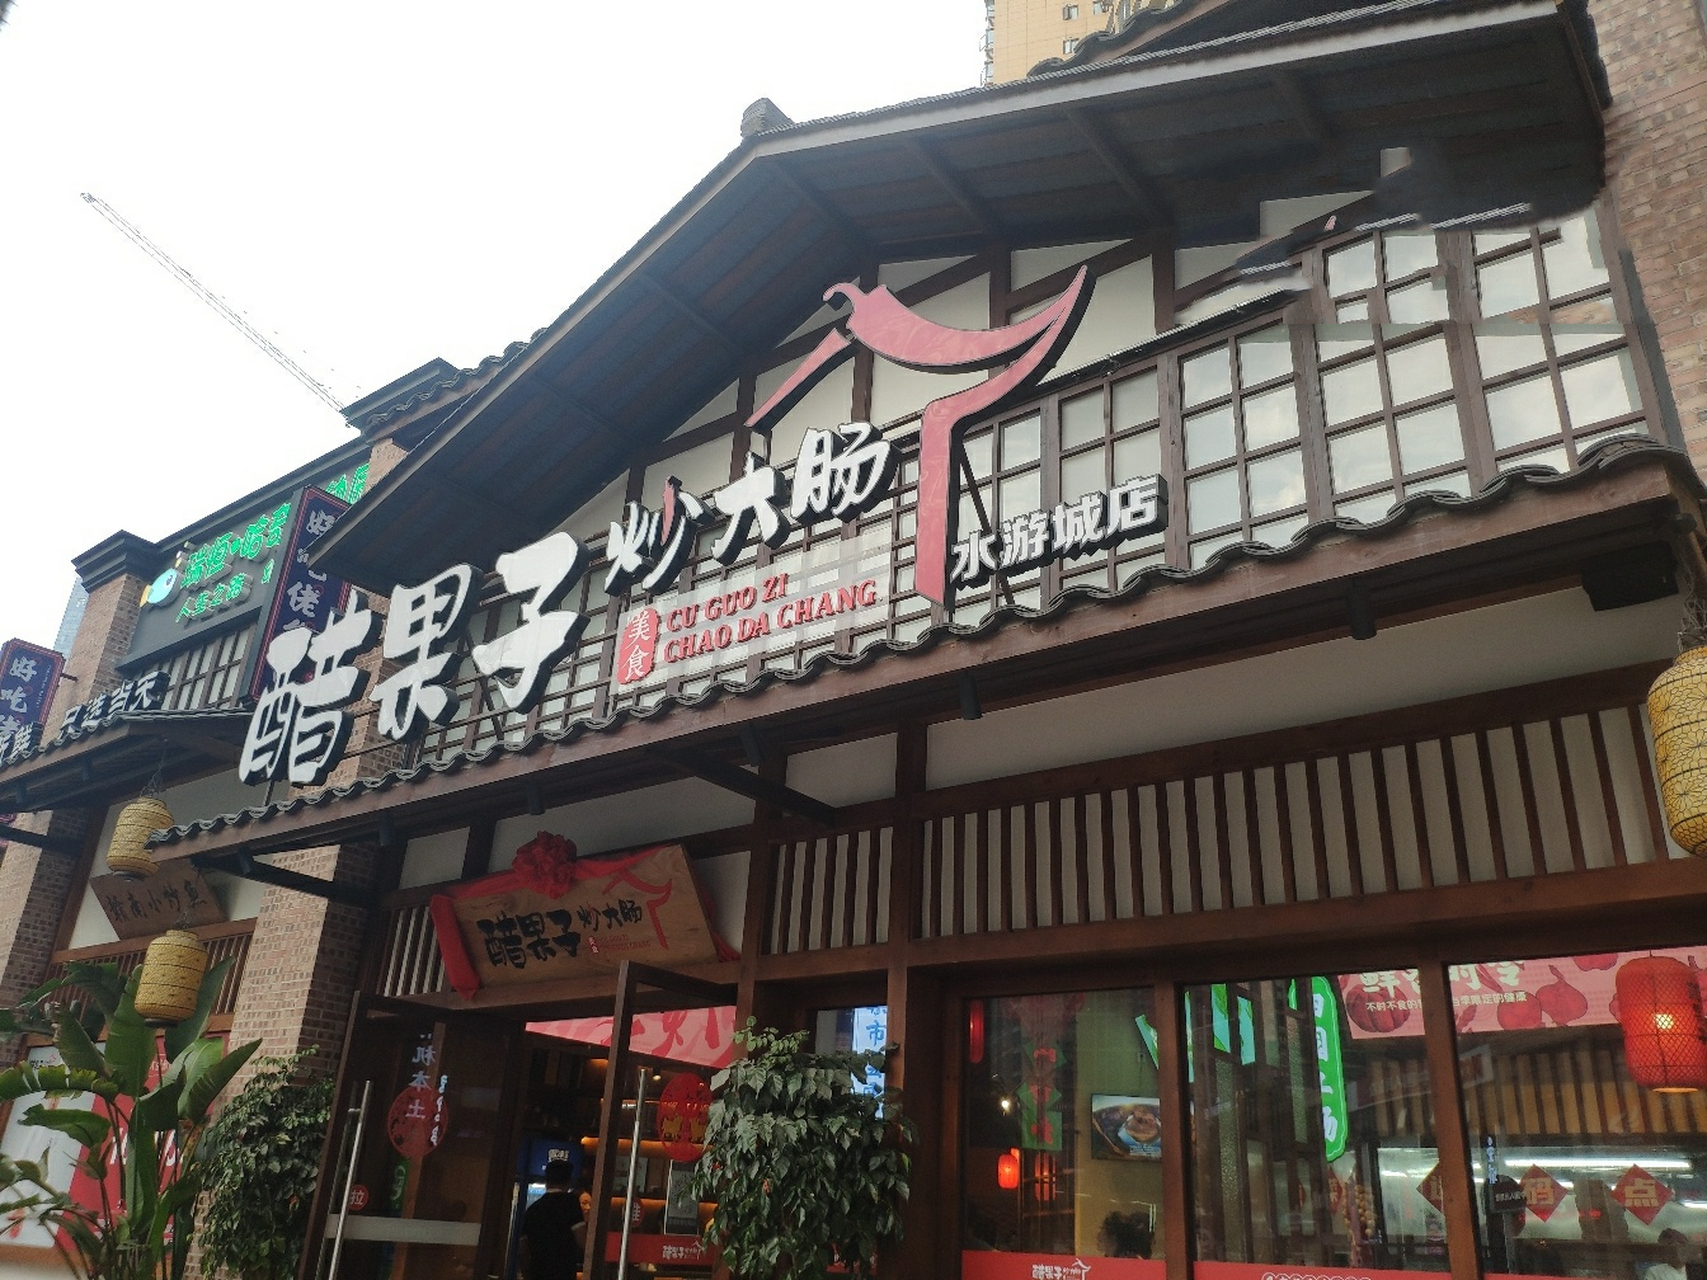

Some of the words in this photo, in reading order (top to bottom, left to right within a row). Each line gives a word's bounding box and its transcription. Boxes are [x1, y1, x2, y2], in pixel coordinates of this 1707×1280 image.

[950, 474, 1159, 582] 水游城店
[664, 625, 731, 664] CHAO
[737, 612, 771, 642] DA
[776, 579, 877, 628] CHANG
[666, 604, 699, 632] CU
[705, 586, 756, 620] GUO
[763, 573, 789, 603] ZI
[624, 610, 652, 680] 美食
